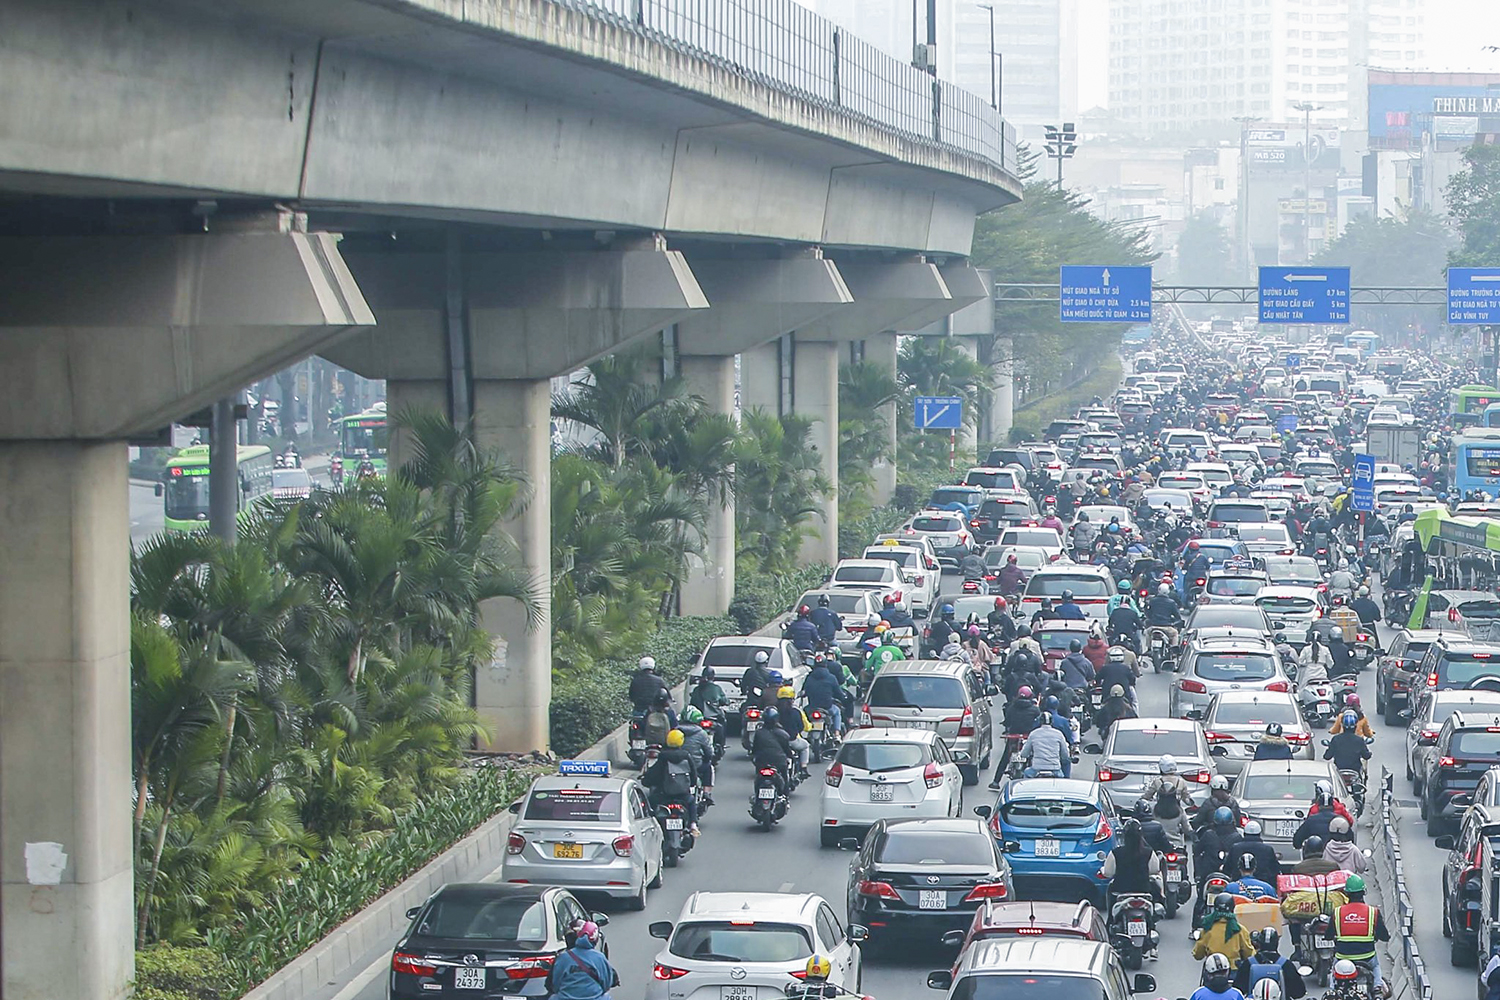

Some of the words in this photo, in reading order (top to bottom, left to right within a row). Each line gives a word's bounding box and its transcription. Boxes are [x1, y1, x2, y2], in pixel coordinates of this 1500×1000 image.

[926, 891, 940, 899] 30A
[1299, 902, 1317, 913] ABC
[463, 969, 478, 977] 30A
